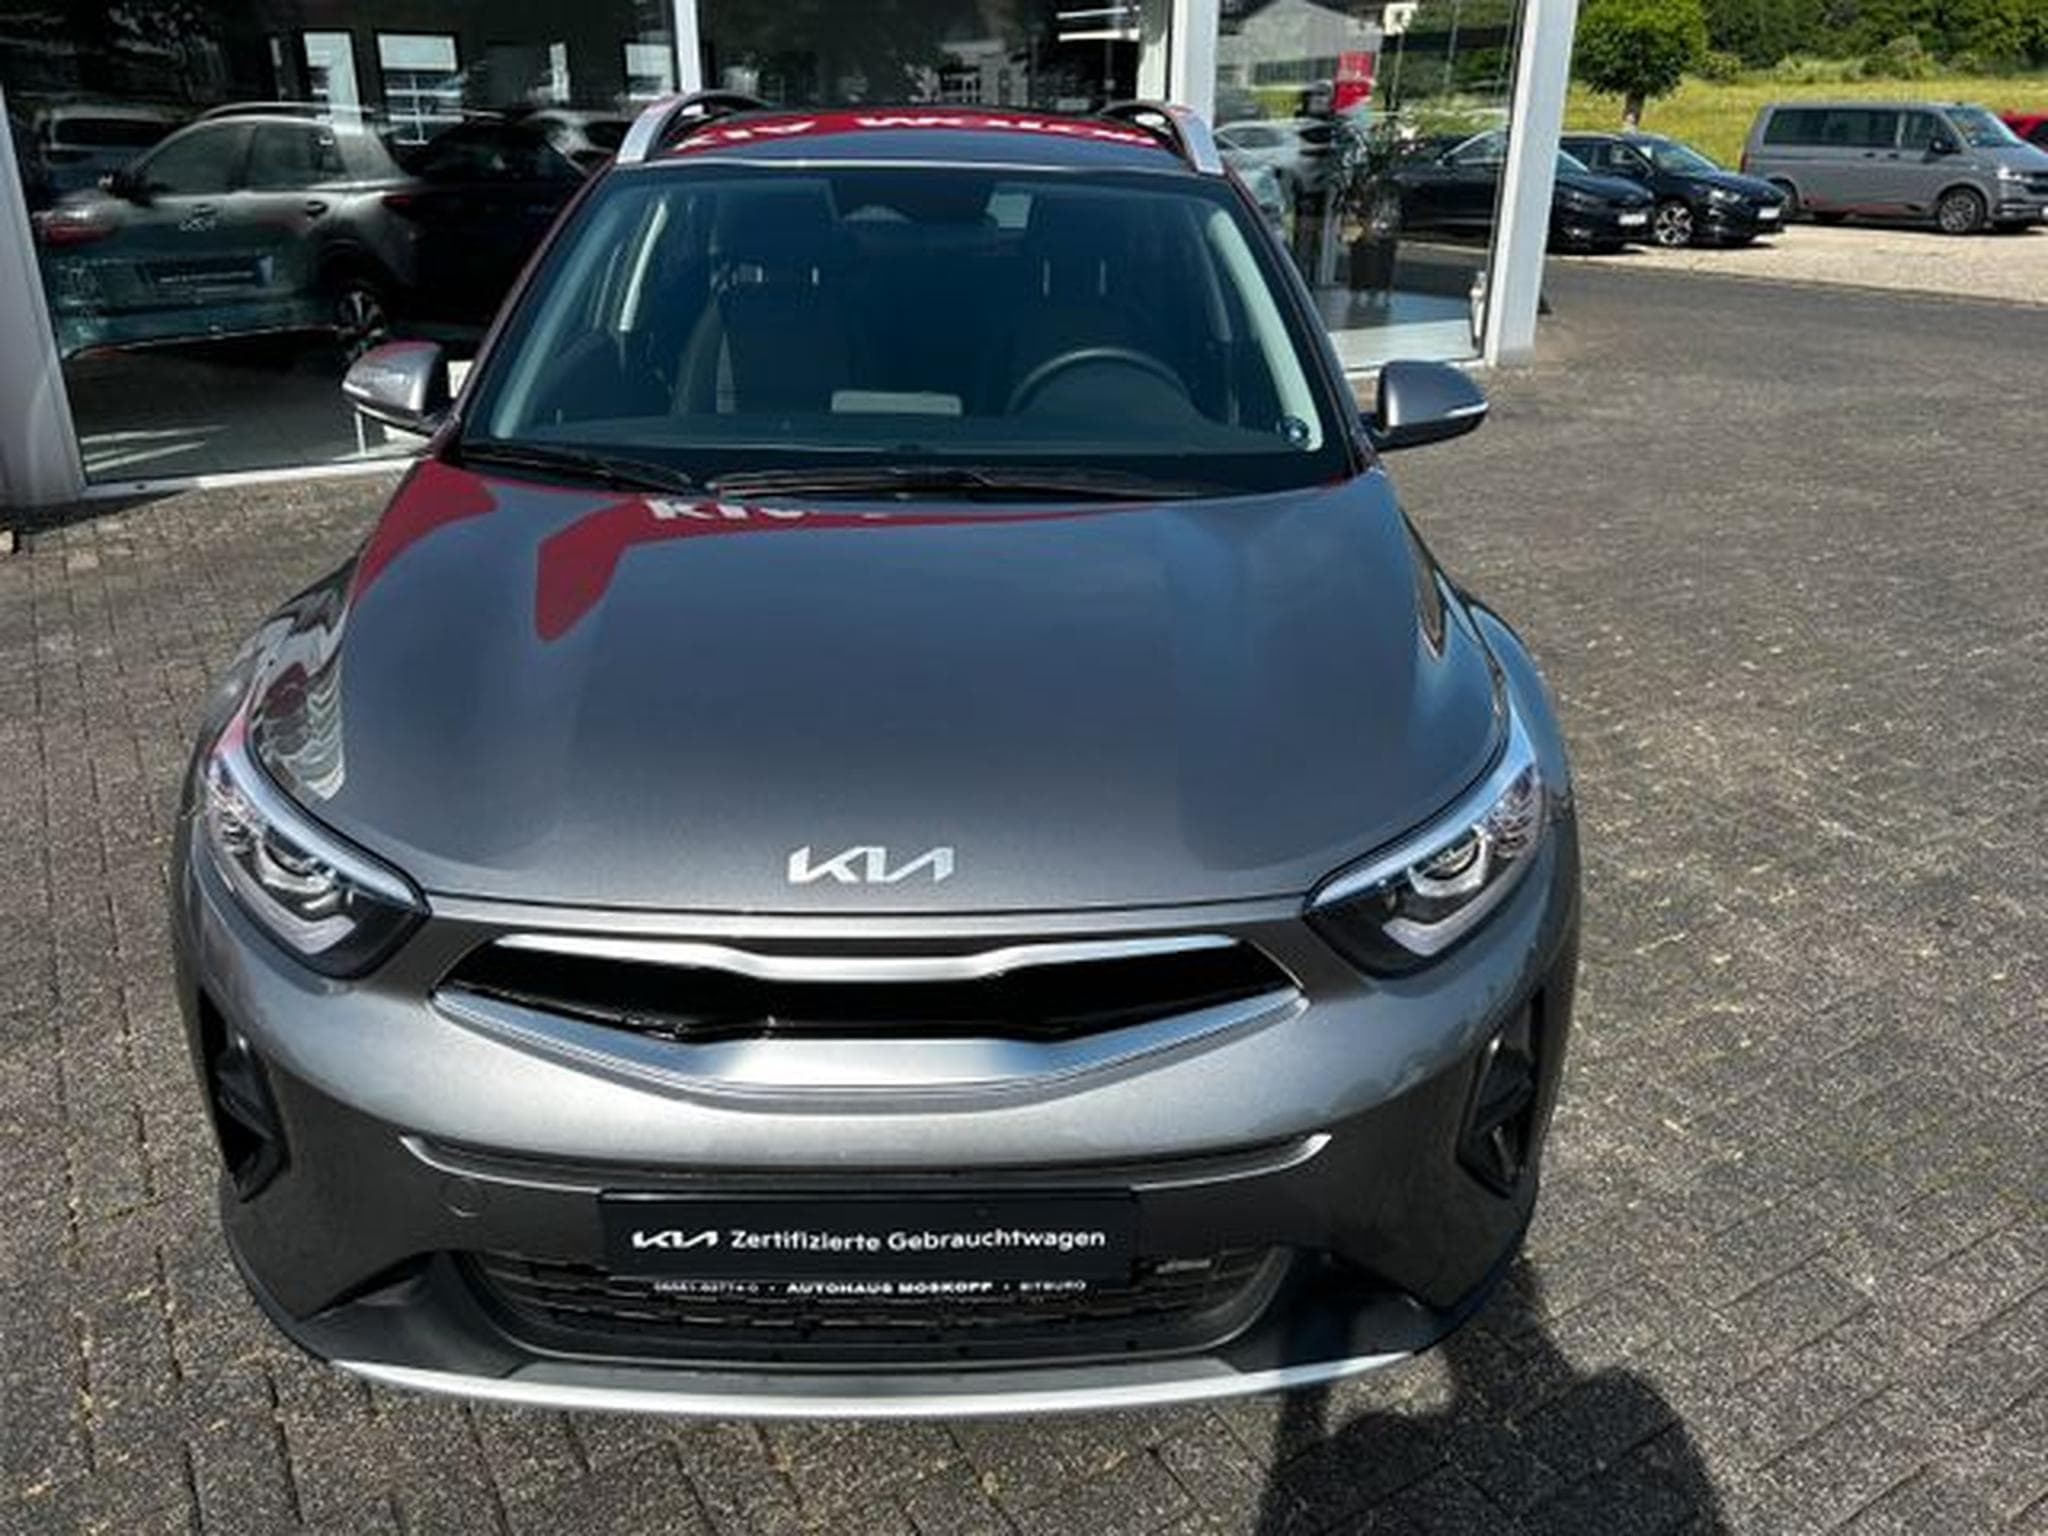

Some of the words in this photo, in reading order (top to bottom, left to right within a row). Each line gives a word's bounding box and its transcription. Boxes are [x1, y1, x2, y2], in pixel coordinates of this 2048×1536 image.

[787, 845, 954, 884] KIA
[632, 1230, 719, 1249] KIA
[731, 1230, 881, 1251] Zertifizierte
[887, 1228, 1106, 1252] Gebrauchtwagen
[786, 1281, 893, 1294] AUTOHAUS
